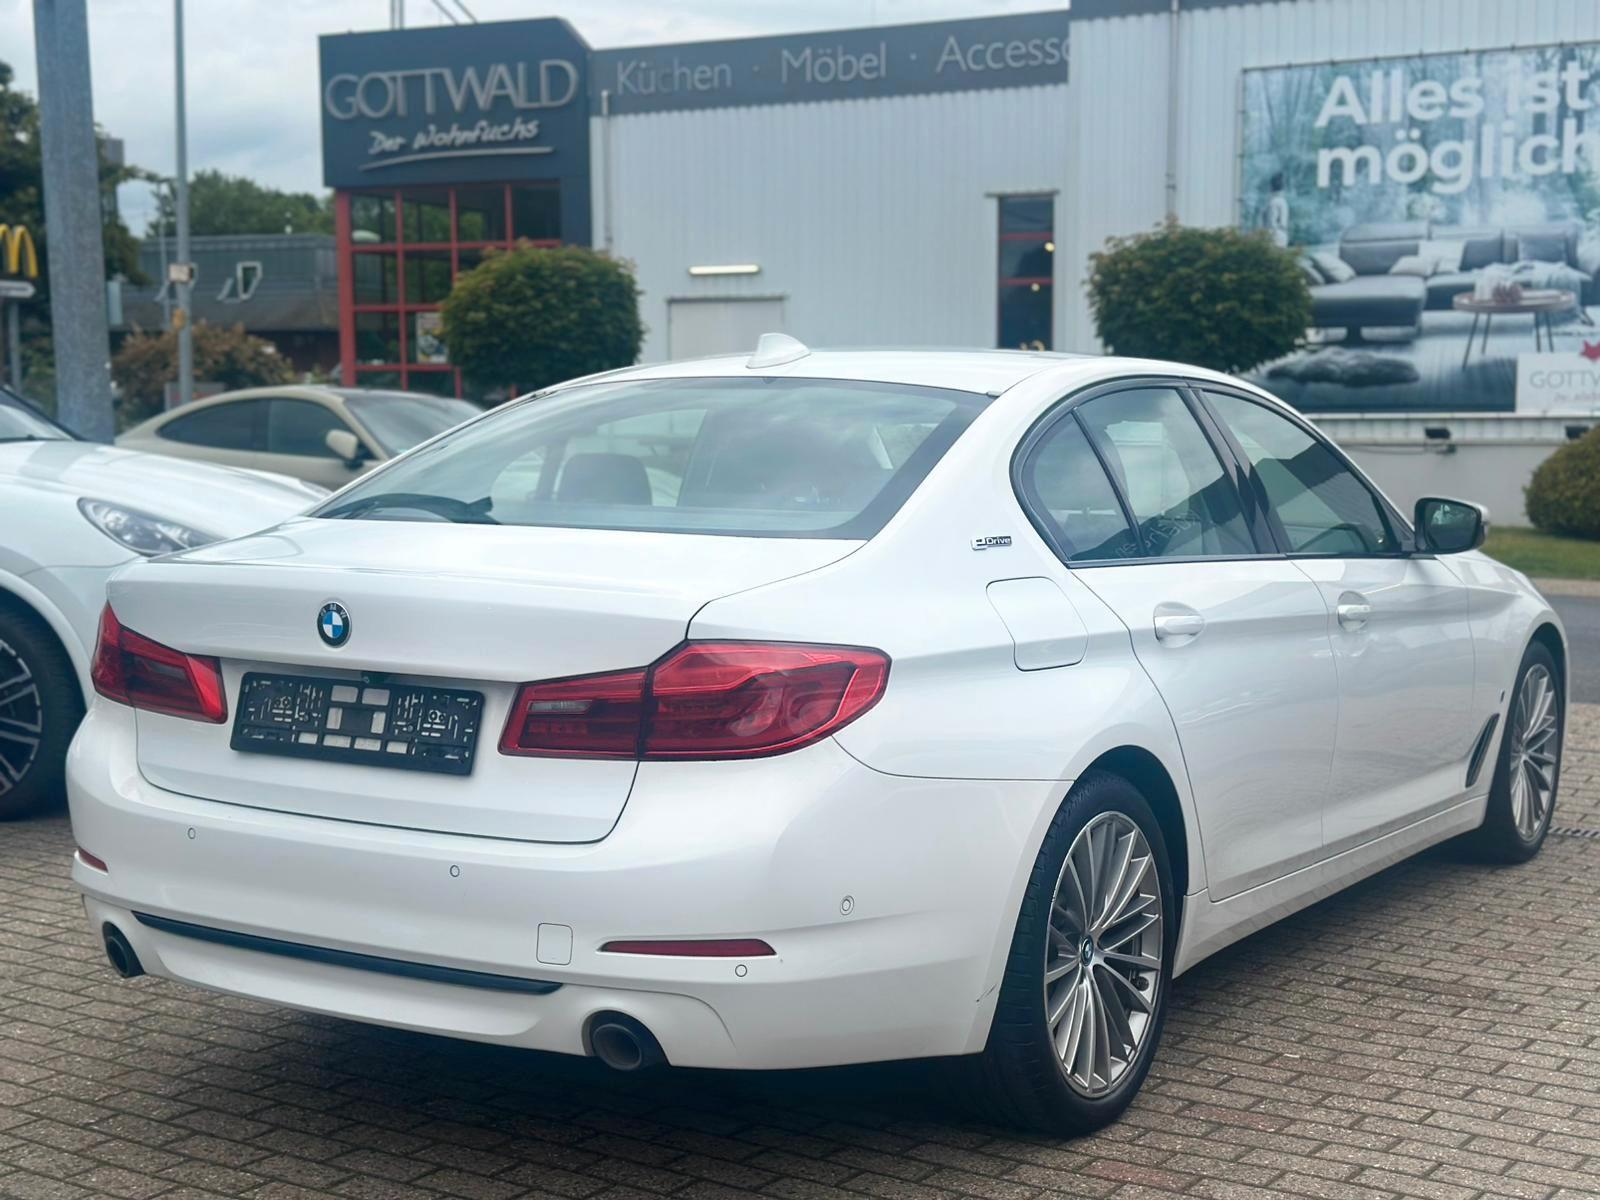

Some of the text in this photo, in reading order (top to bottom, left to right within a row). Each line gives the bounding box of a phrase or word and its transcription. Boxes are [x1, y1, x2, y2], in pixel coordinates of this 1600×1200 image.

[325, 59, 579, 120] GOTTWALD
[616, 60, 733, 96] Küchen
[781, 41, 887, 84] Möbel
[1314, 53, 1592, 128] Alles ist
[368, 116, 540, 155] Der Wohnfuchs
[1316, 117, 1600, 195] möglich
